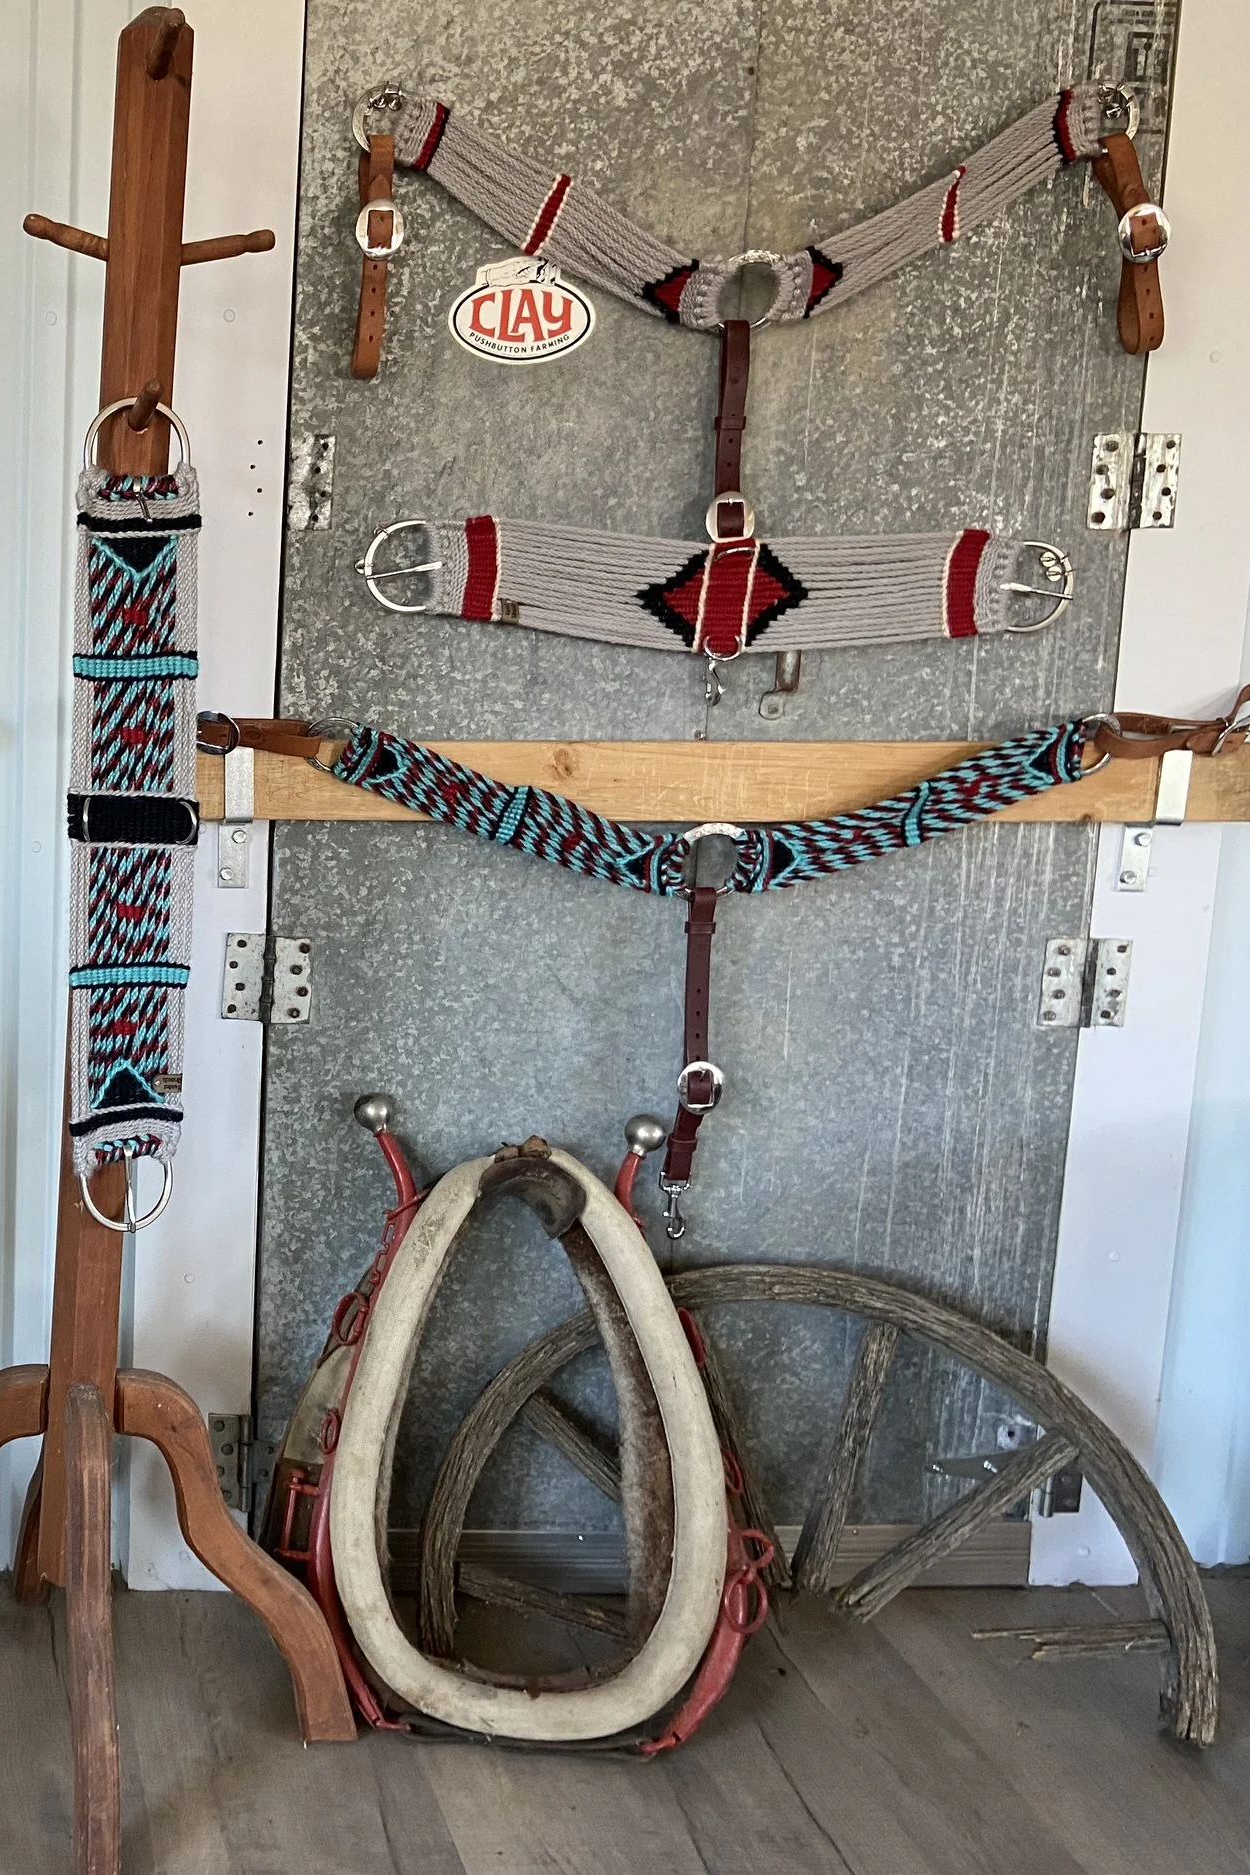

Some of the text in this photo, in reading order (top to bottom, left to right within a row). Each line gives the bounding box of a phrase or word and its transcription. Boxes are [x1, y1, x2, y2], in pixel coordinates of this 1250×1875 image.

[468, 288, 574, 343] CLAY
[469, 331, 570, 353] PUSHBUTTON FARMING
